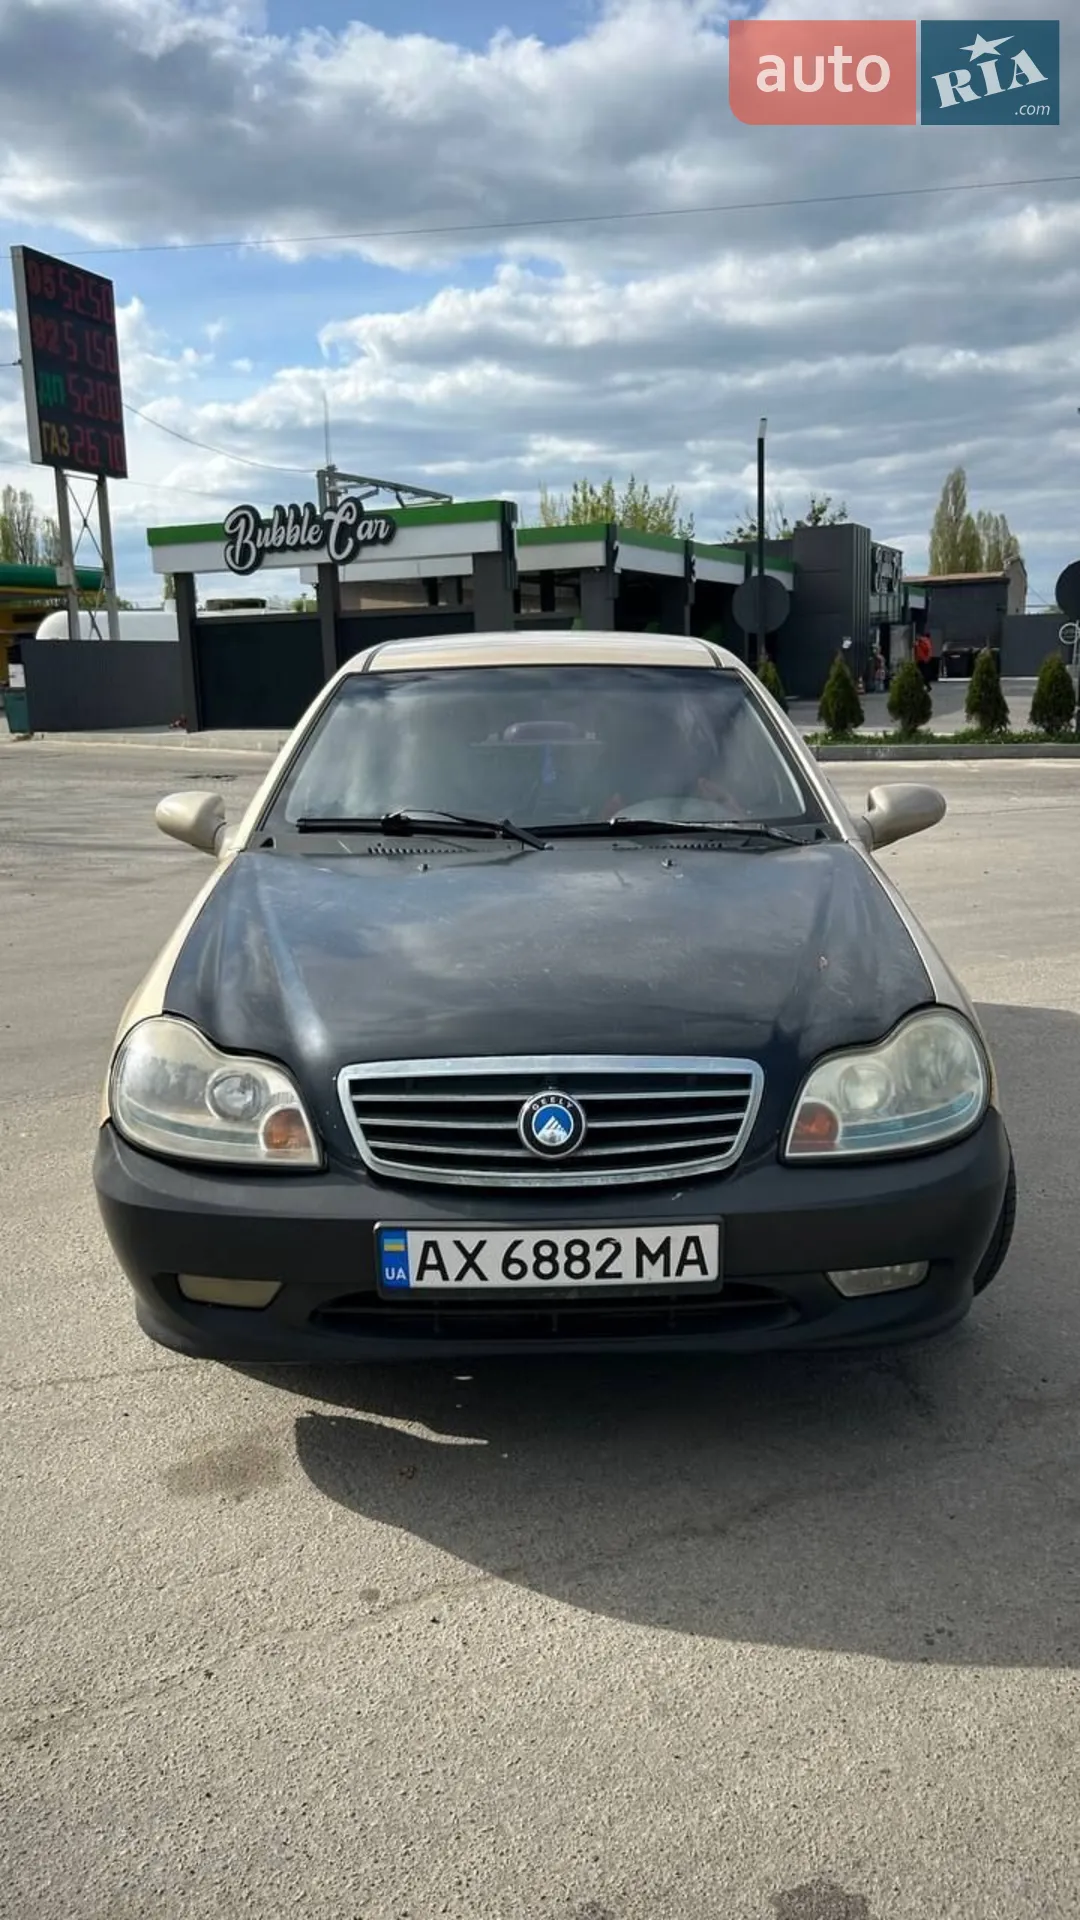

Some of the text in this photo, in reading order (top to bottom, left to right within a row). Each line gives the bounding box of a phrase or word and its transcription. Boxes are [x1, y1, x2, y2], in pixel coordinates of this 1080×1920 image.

[41, 420, 70, 457] ГАЗ
[224, 500, 391, 572] Bubble Car
[384, 1267, 407, 1281] UA
[415, 1235, 709, 1282] AX 6882 MA
